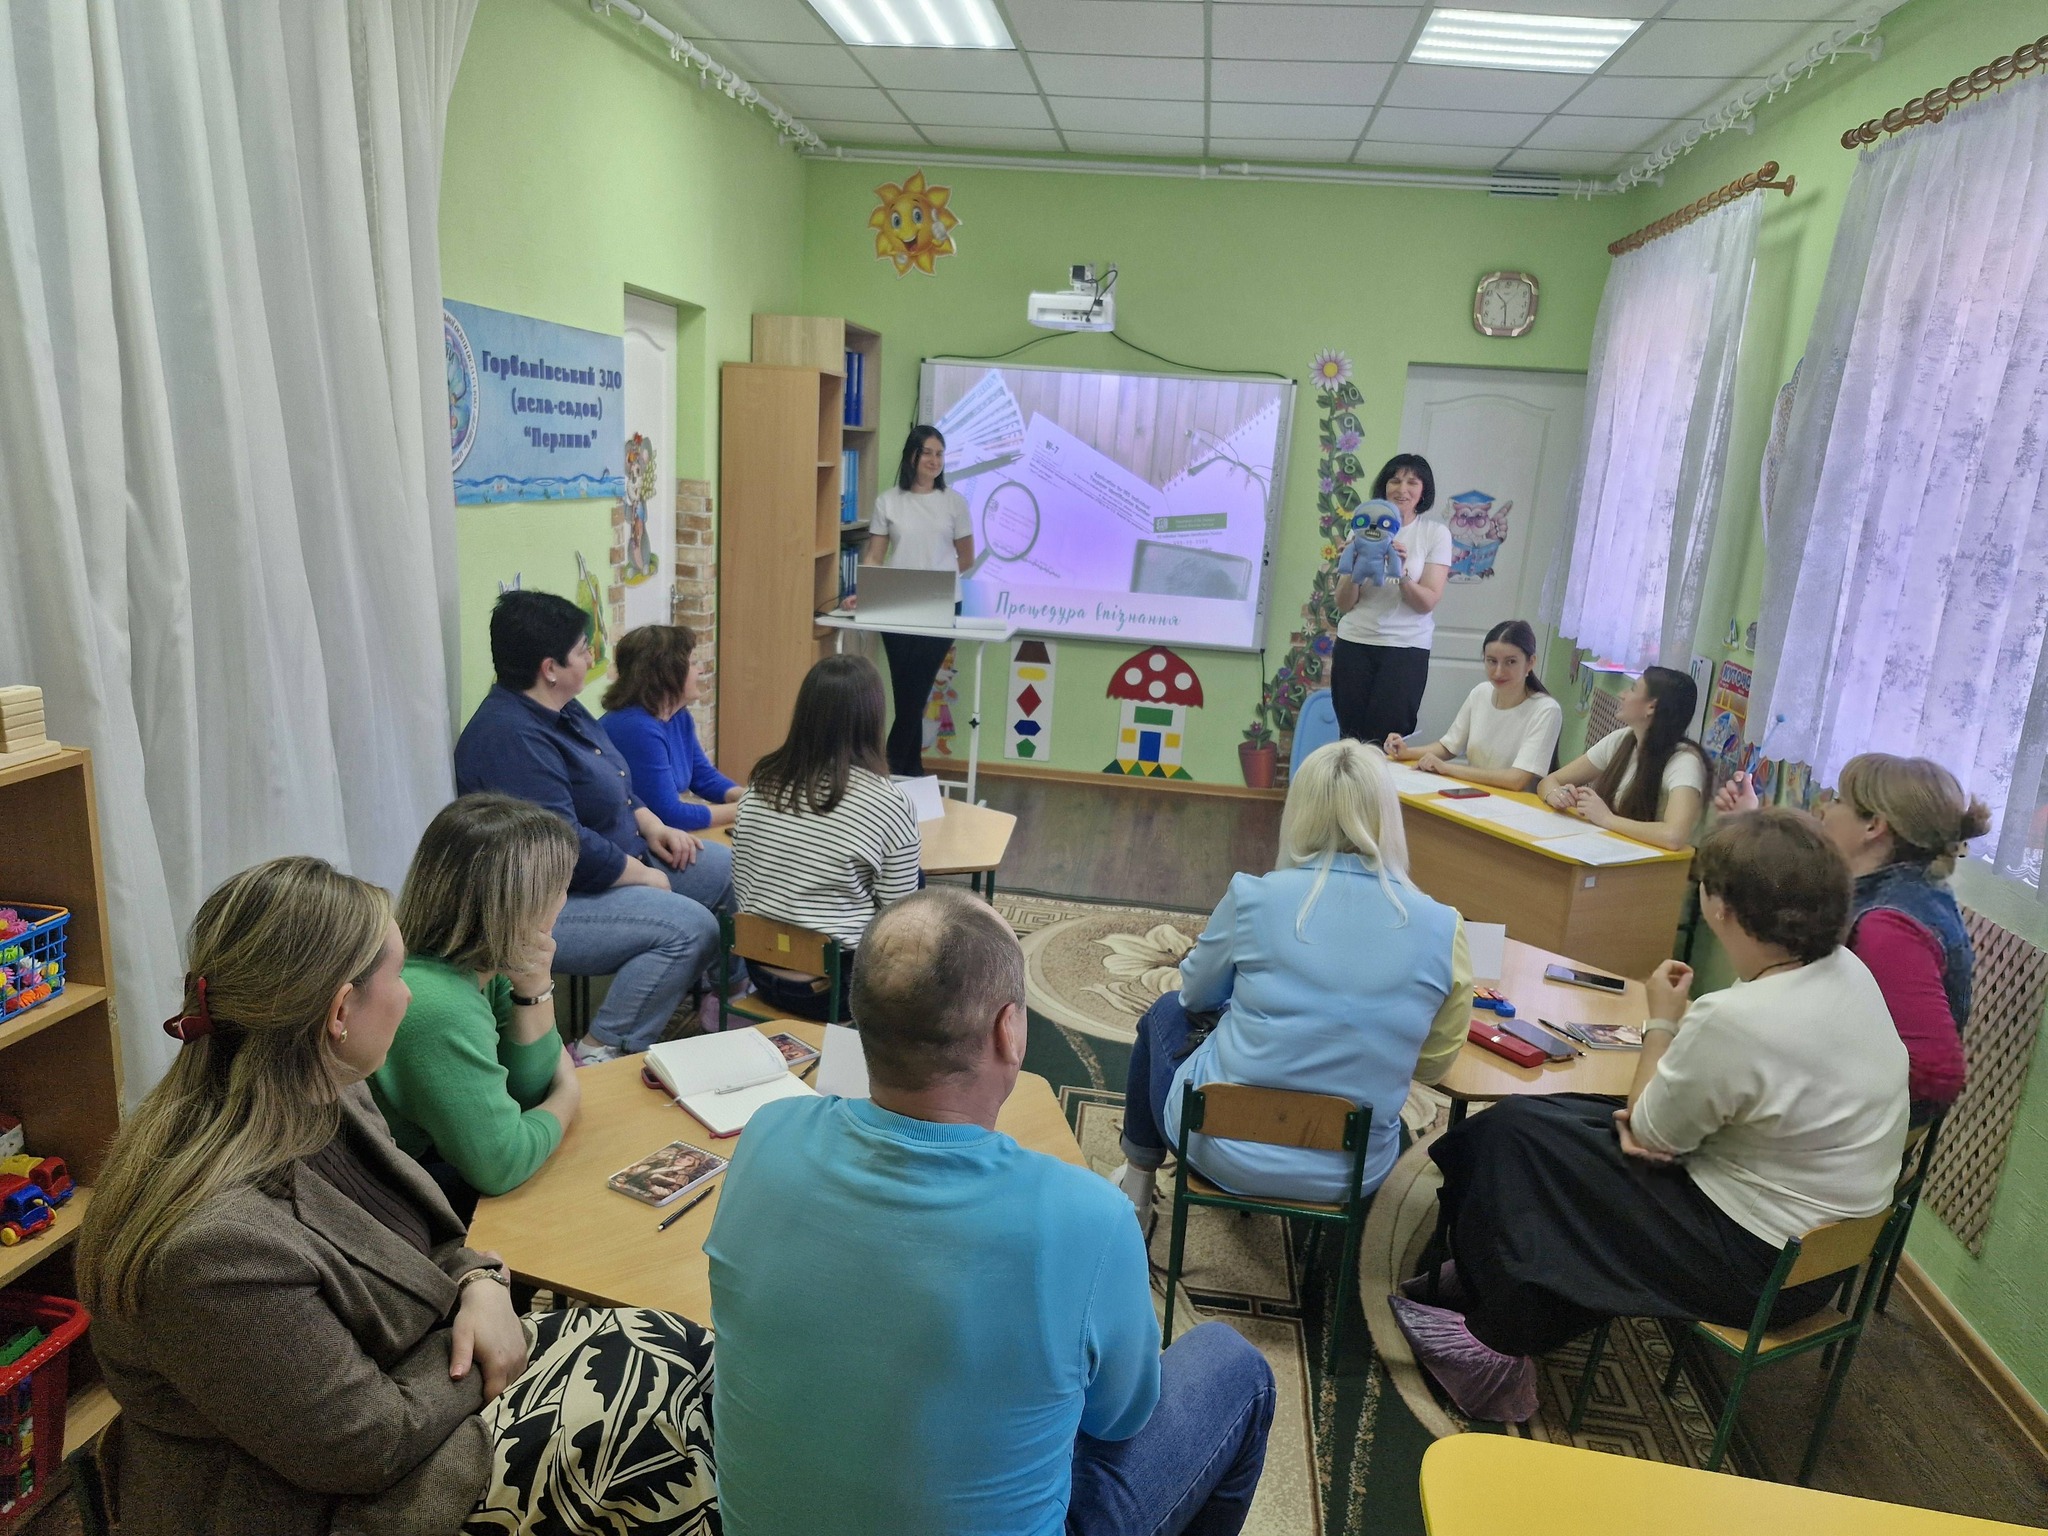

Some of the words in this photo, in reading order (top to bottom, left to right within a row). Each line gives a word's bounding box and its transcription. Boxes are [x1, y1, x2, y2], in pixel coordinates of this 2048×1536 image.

[482, 350, 596, 386] Горбанівський
[599, 368, 622, 391] ЗДО
[1340, 386, 1359, 404] 10
[511, 387, 603, 421] (ясла-садок)
[1343, 416, 1355, 432] 9
[1344, 457, 1356, 474] 8
[1343, 491, 1354, 508] 7
[995, 591, 1086, 625] Процедура
[1095, 602, 1181, 632] впізнання
[1330, 610, 1340, 623] 4
[1306, 659, 1320, 675] 3
[1290, 685, 1304, 702] 2
[1279, 709, 1286, 725] 1
